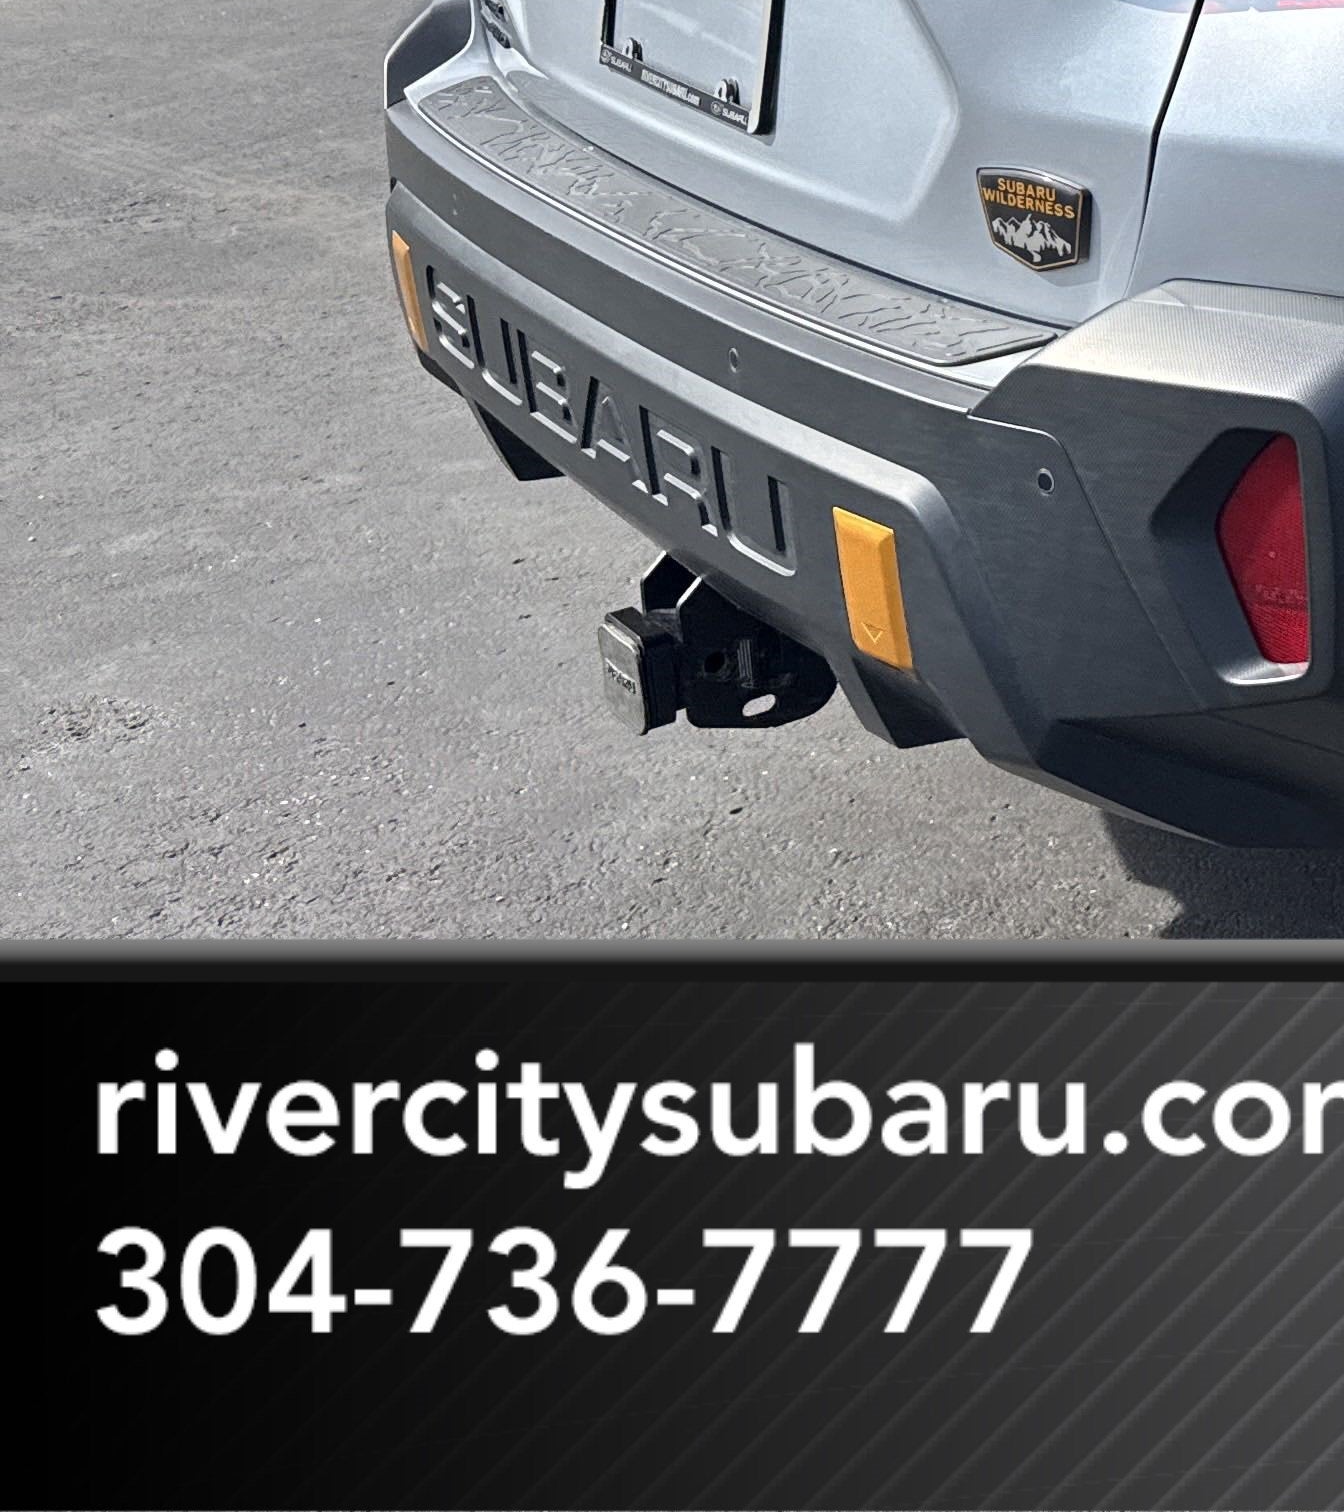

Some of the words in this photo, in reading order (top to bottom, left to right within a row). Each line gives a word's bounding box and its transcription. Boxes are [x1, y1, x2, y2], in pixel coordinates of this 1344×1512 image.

[982, 187, 1076, 219] WILDERNESS
[997, 177, 1056, 201] SUBARU
[426, 265, 797, 577] SUBARU
